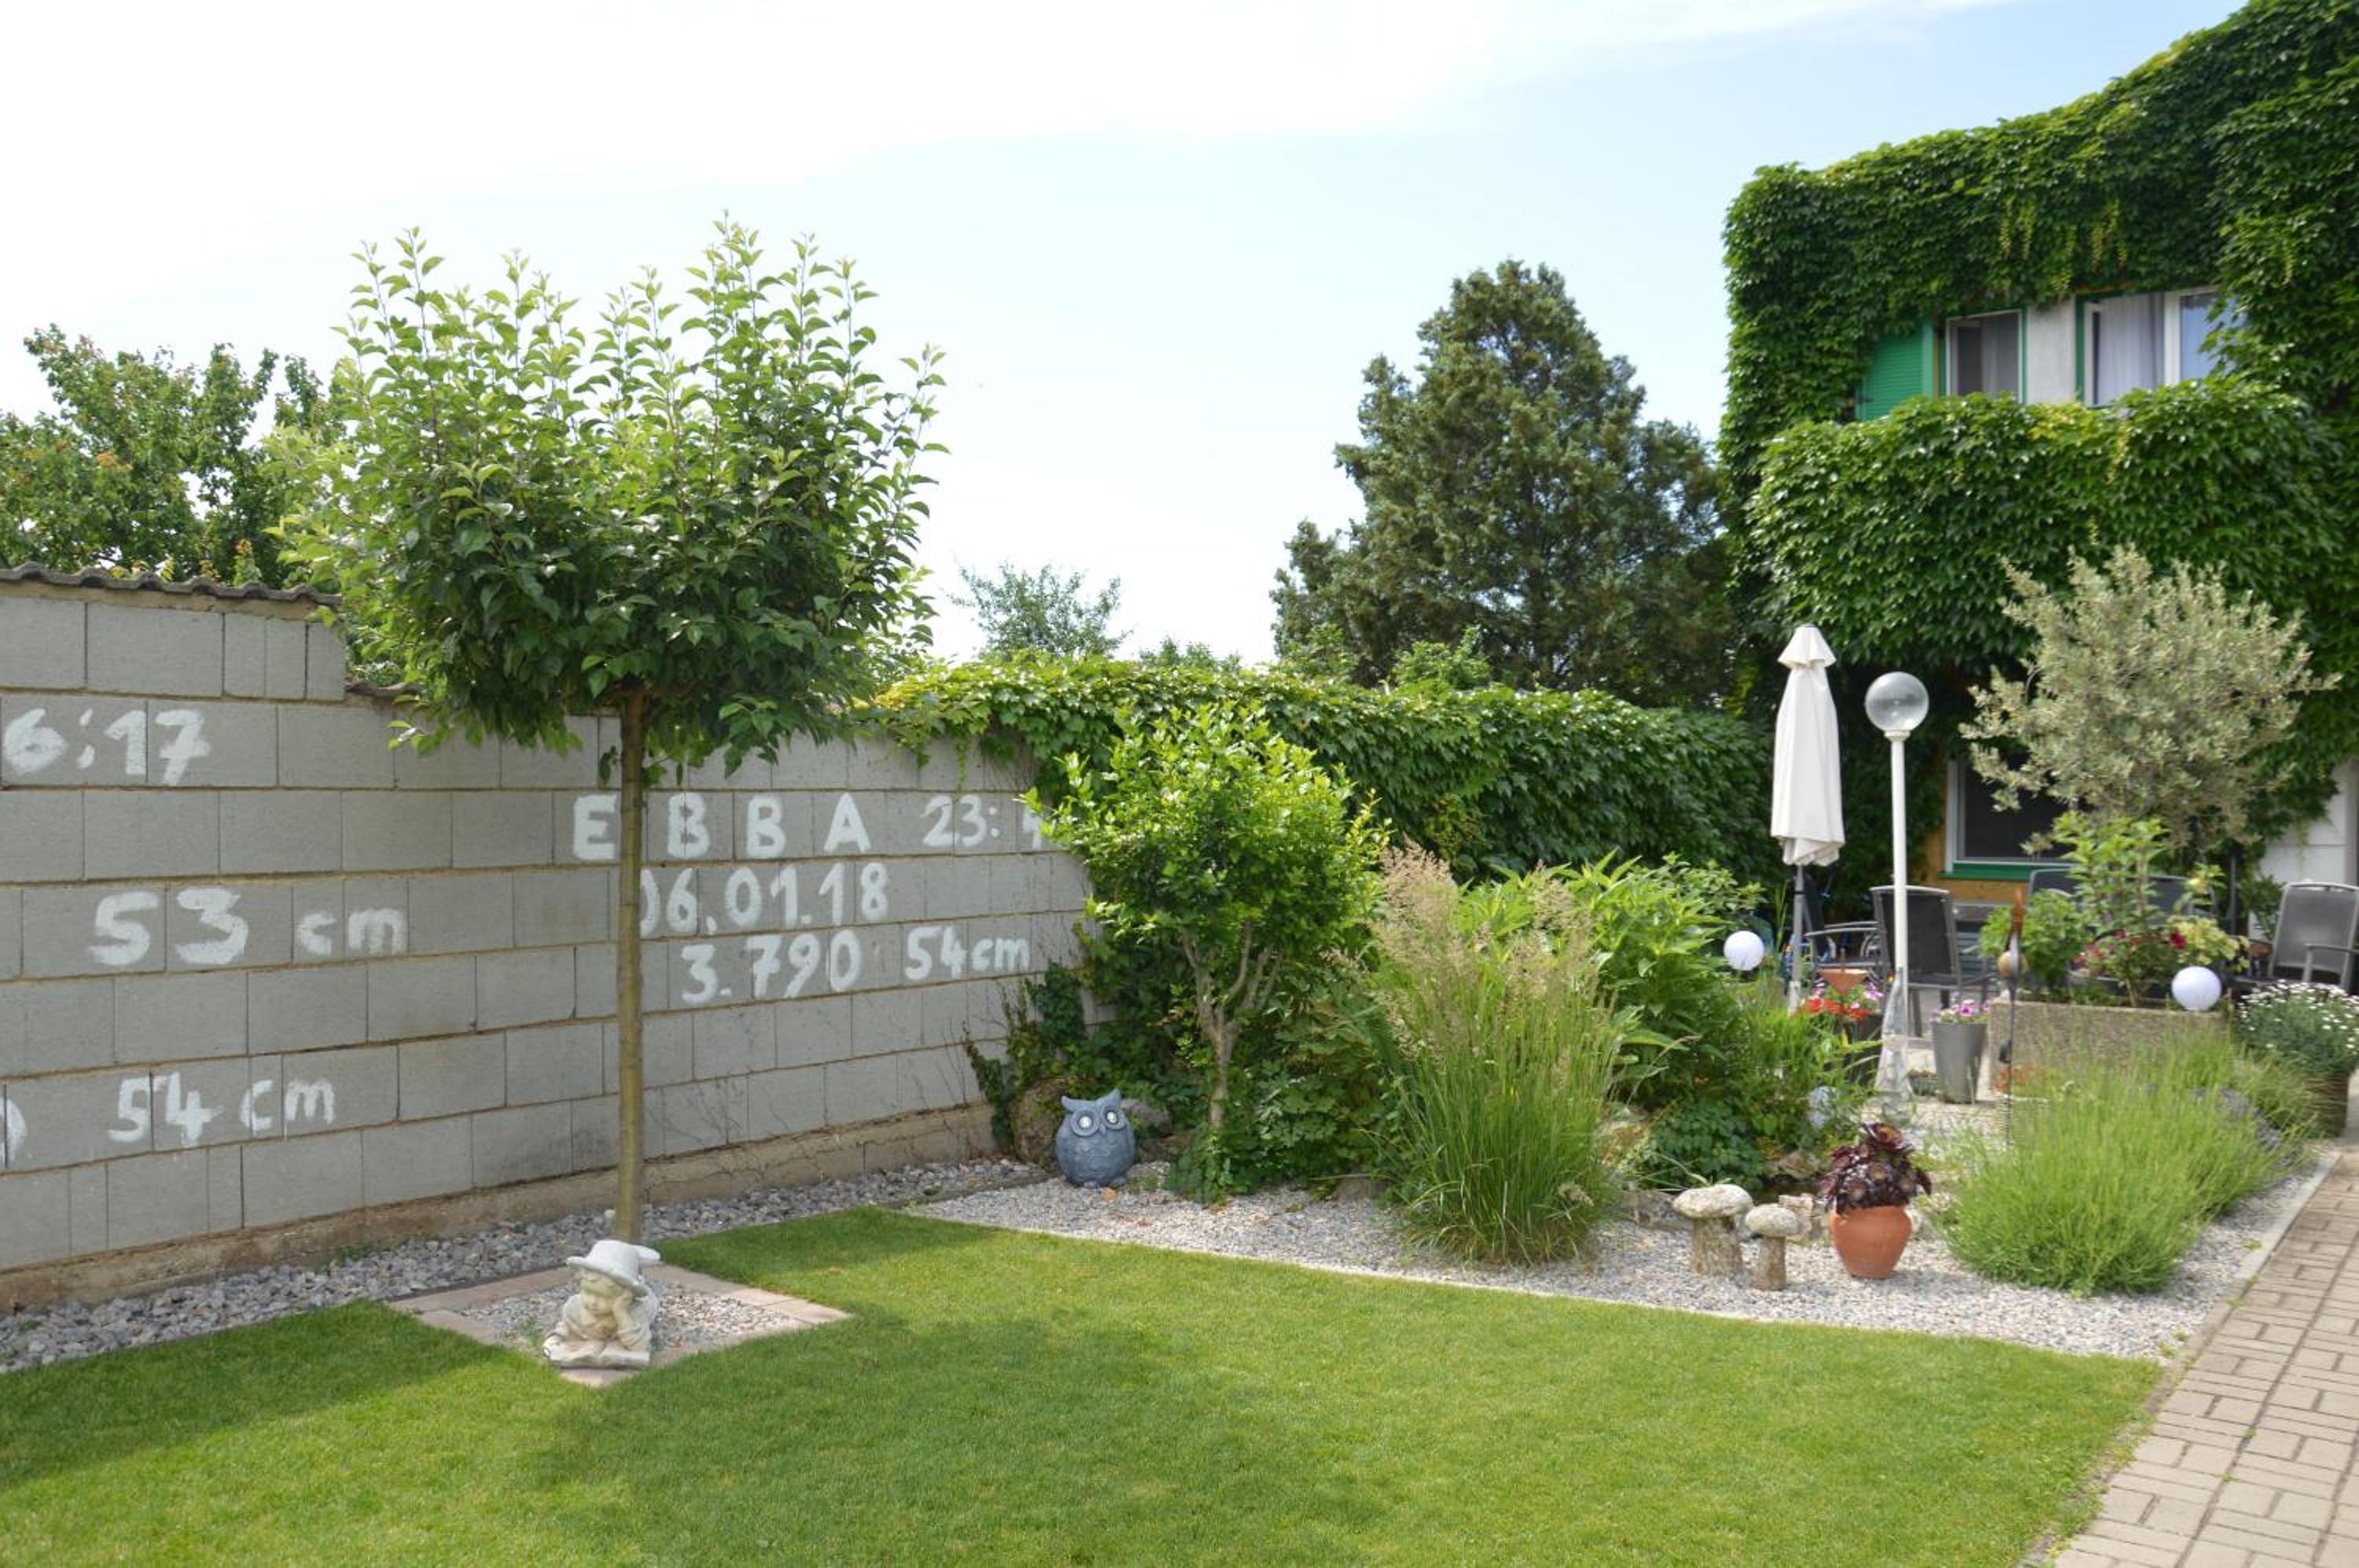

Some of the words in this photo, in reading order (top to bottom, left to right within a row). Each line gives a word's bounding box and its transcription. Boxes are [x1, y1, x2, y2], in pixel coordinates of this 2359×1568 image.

[3, 708, 212, 786] 6:17
[88, 887, 248, 965] 53
[296, 908, 408, 955] cm
[681, 929, 862, 1005] 3.790
[108, 1073, 224, 1147] 54
[239, 1078, 336, 1135] cm
